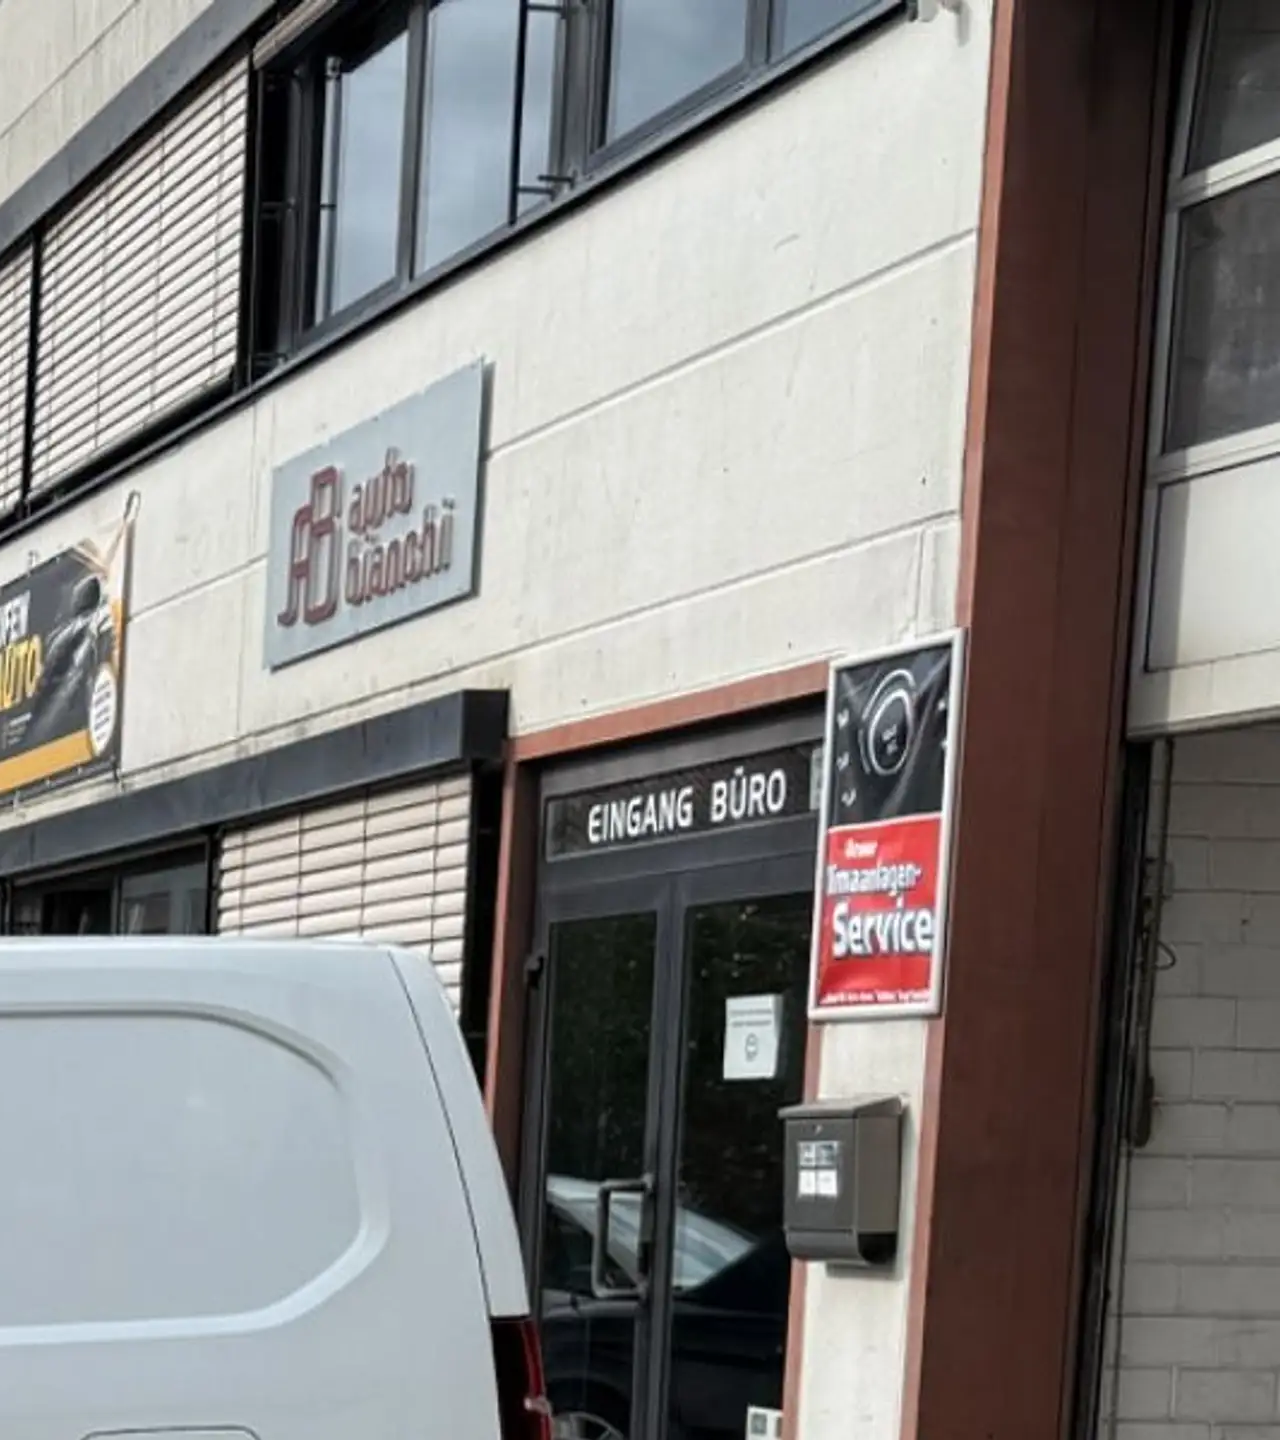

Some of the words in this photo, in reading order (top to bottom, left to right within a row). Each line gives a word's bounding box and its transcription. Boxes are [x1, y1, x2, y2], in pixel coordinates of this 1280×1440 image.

[588, 786, 694, 843] EINGANG
[710, 766, 787, 823] BÜRO
[832, 897, 936, 958] Service
